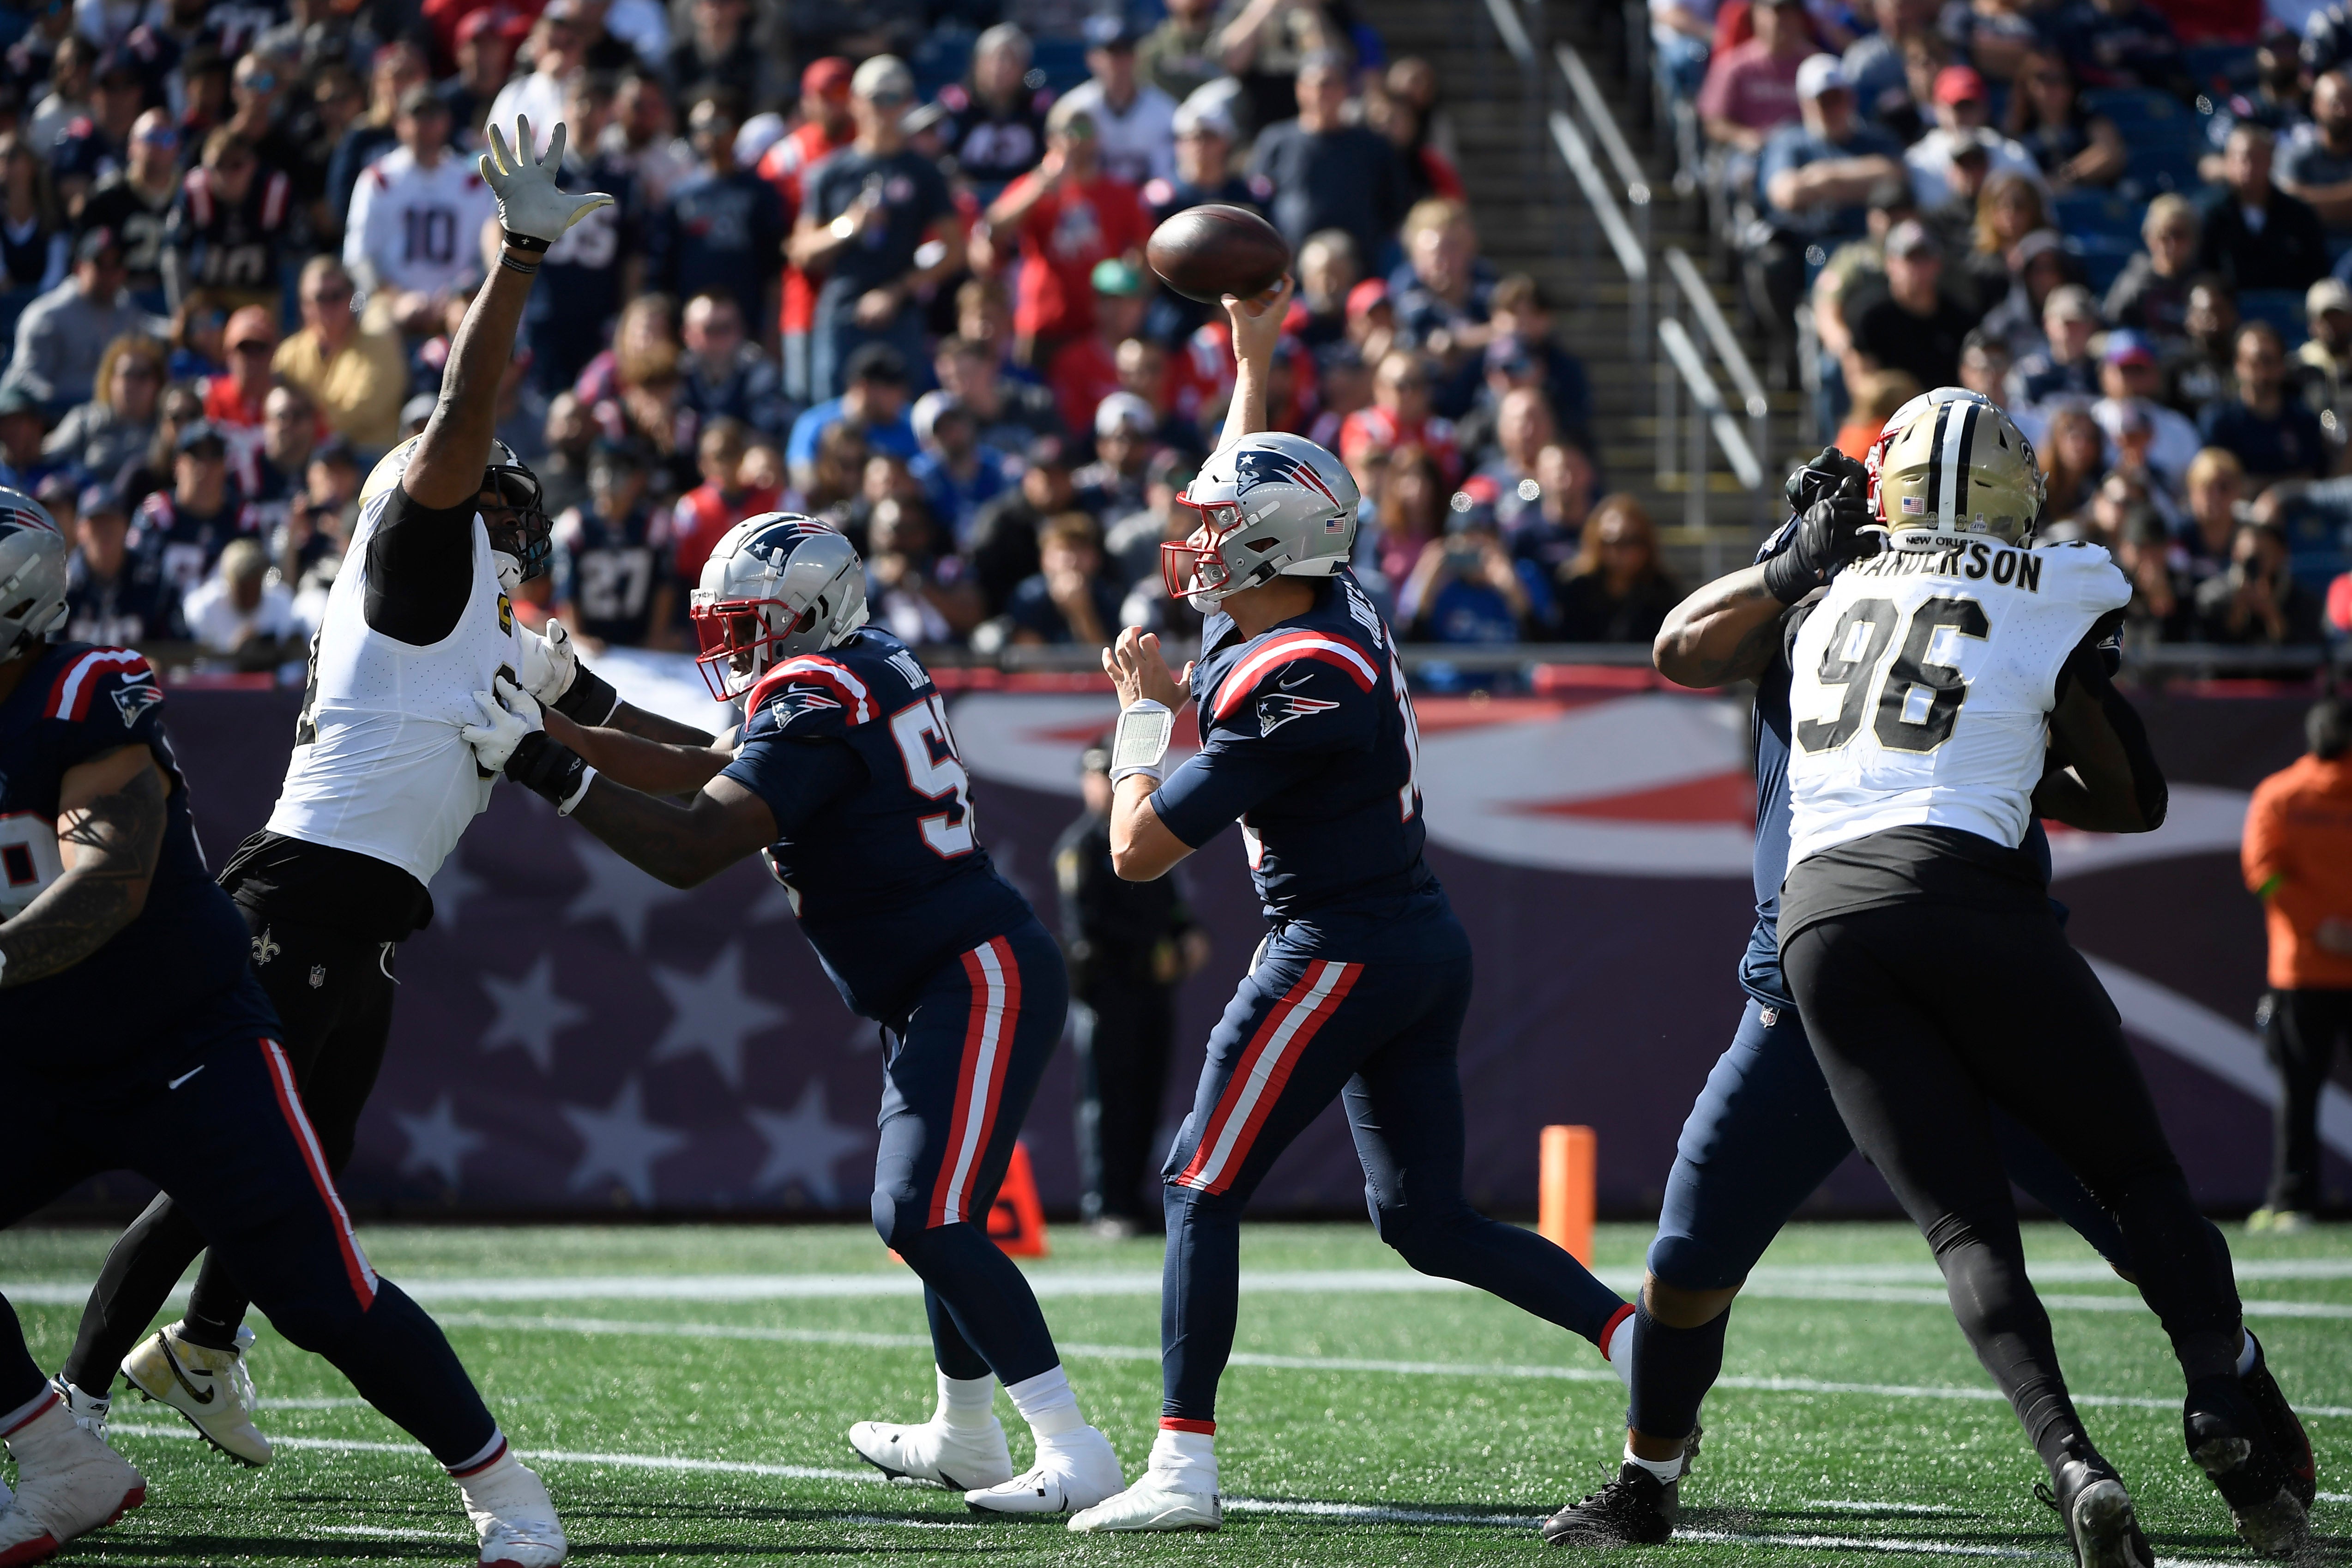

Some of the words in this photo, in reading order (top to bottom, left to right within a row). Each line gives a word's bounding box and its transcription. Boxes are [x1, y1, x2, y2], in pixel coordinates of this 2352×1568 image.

[404, 207, 455, 264] 10
[581, 549, 650, 617] 27
[1797, 595, 1991, 756] 96
